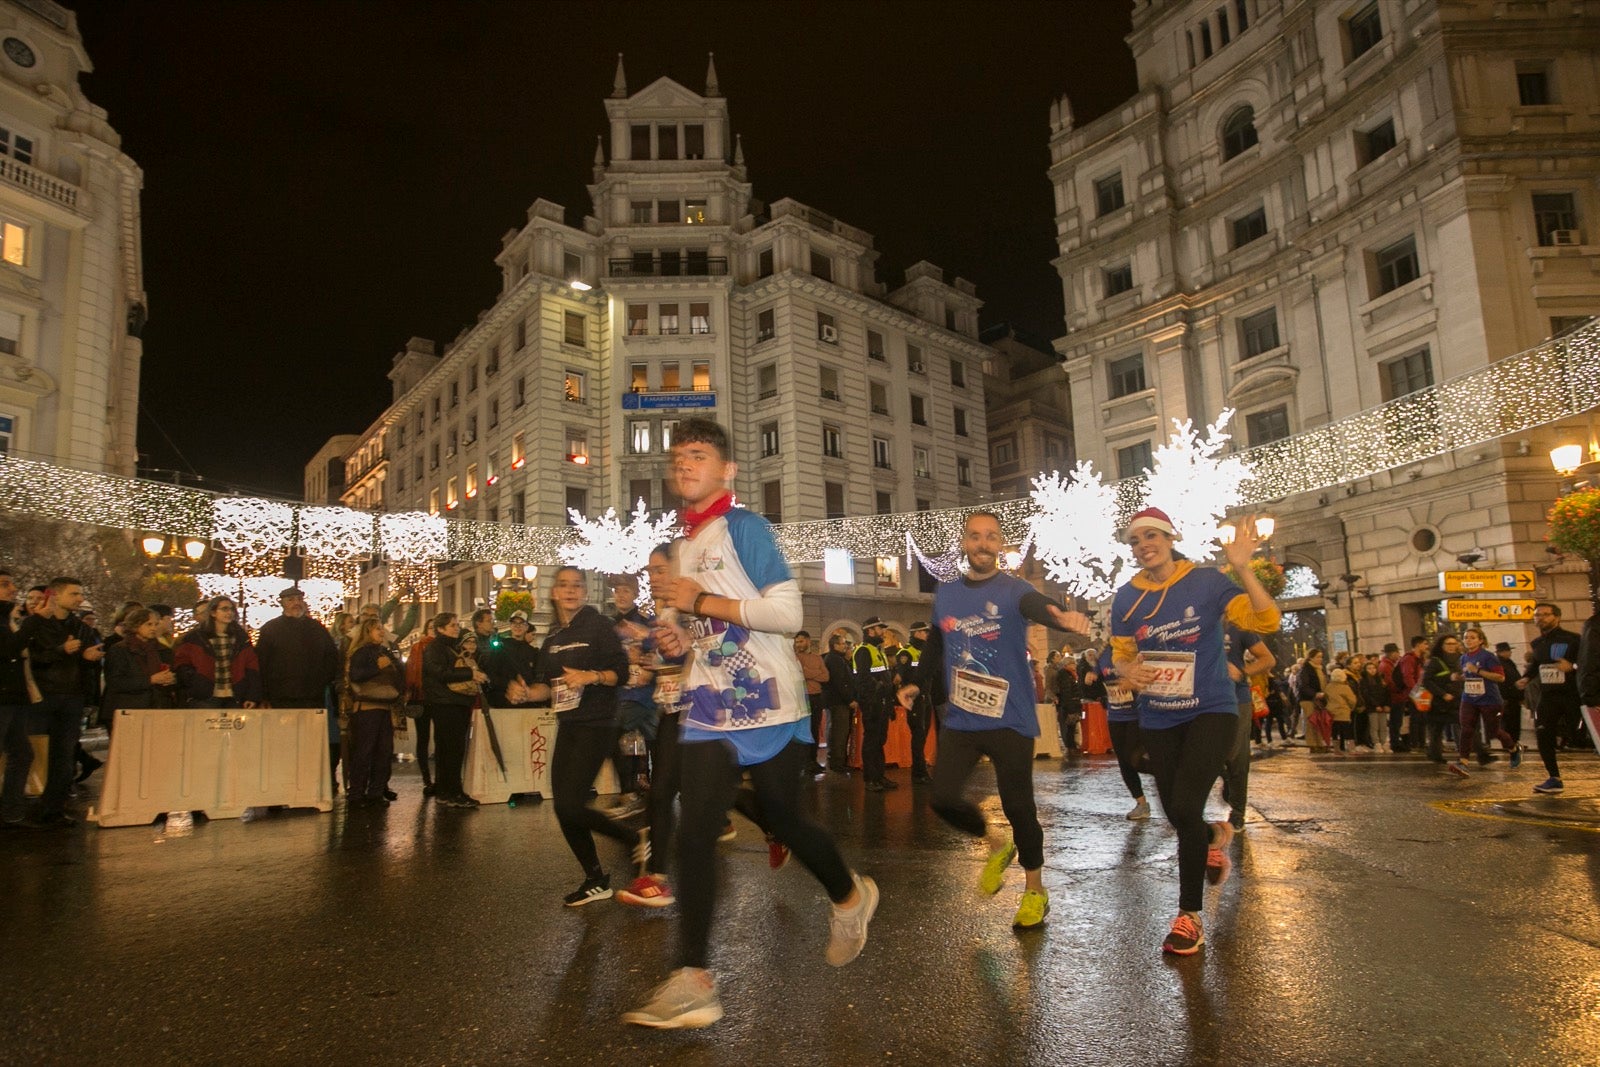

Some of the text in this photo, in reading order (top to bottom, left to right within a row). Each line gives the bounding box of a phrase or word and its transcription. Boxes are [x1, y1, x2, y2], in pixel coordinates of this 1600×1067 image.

[1449, 602, 1479, 610] Oficina
[1147, 620, 1181, 637] Carrera
[1156, 625, 1201, 641] Nocturna
[961, 686, 998, 707] 1295
